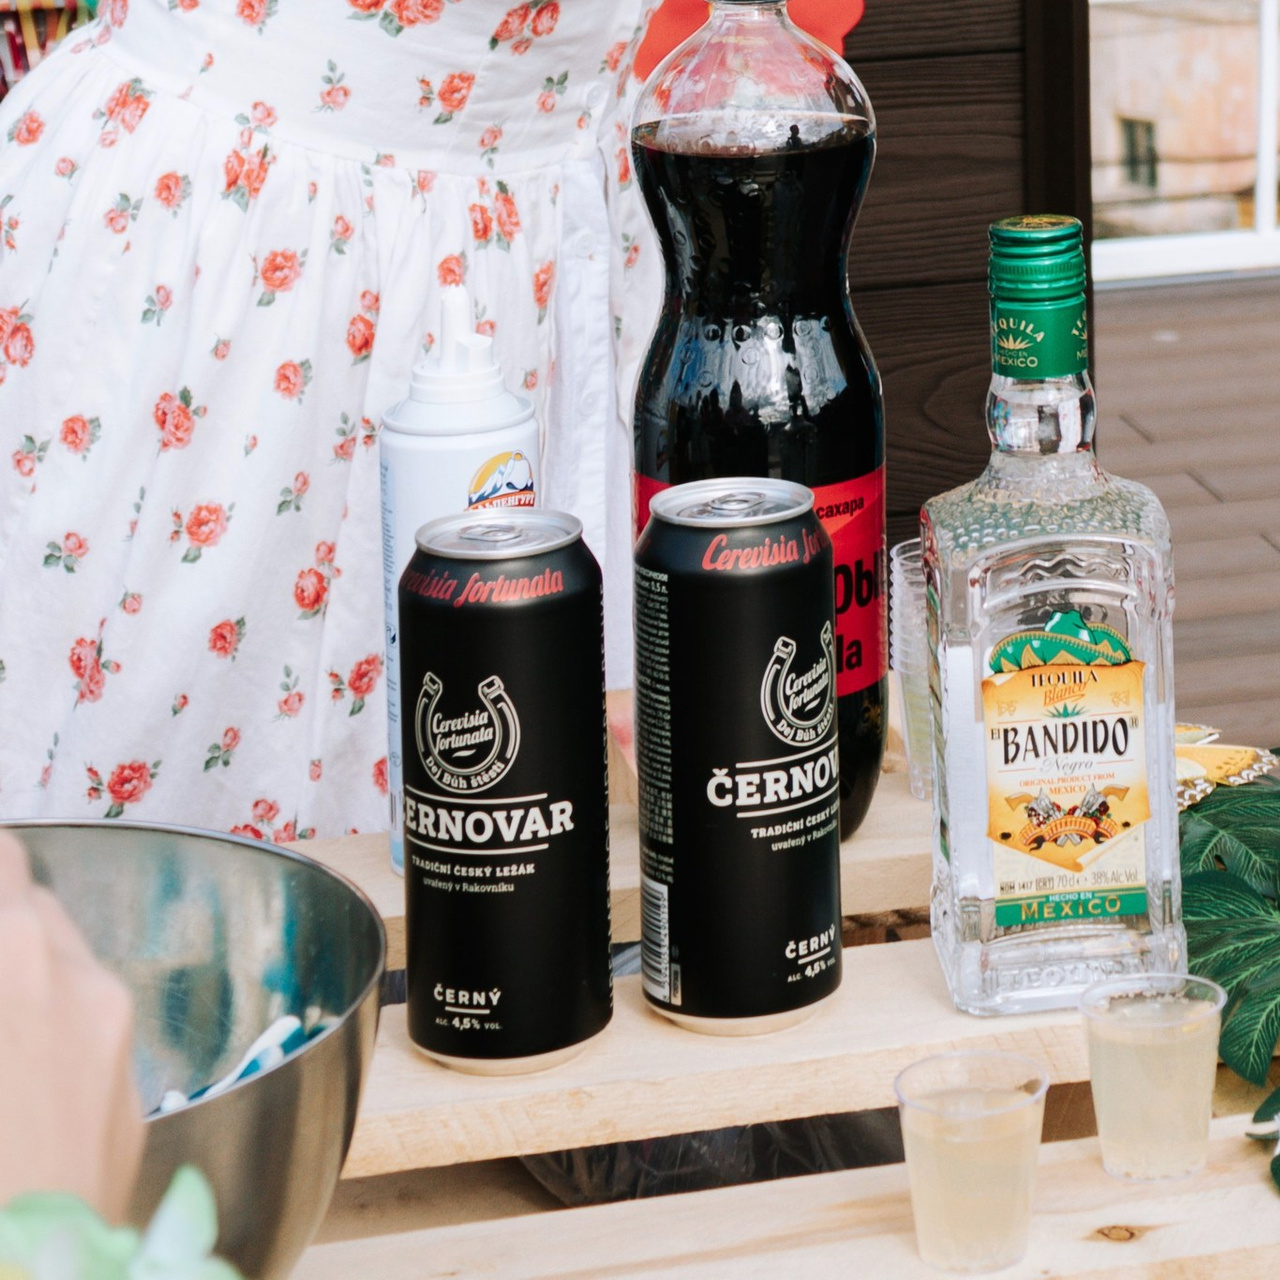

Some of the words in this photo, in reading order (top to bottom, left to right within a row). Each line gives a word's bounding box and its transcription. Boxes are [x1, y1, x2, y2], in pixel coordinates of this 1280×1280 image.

[994, 353, 1038, 368] MEXICO
[816, 497, 864, 519] сахара
[702, 534, 799, 571] Cerevisia
[453, 567, 564, 608] fortunata
[836, 634, 862, 672] la
[785, 657, 827, 696] Cerevisia
[1032, 670, 1098, 688] TEQUILA
[1044, 682, 1087, 707] Blanco
[432, 709, 489, 734] Cerevisia
[435, 726, 494, 755] fortunata
[1003, 717, 1129, 765] BANDIDO
[426, 756, 440, 779] Dej
[442, 774, 468, 789] Bůh
[470, 760, 506, 788] štěstí
[1040, 756, 1094, 775] Negro
[1020, 778, 1054, 787] ORIGINAL
[1057, 775, 1091, 783] PRODUCT
[1094, 772, 1115, 780] FROM
[1050, 785, 1087, 795] MEXICO
[404, 796, 574, 843] ERNOVAR
[751, 818, 805, 839] TRADIČNÍ
[805, 807, 830, 827] ČESKÝ
[412, 855, 451, 875] TRADIČNÍ
[454, 863, 491, 877] ČESKÝ
[496, 863, 535, 877] LEŽÁK
[455, 884, 460, 892] v
[462, 882, 515, 893] Rakovníku
[1049, 893, 1078, 902] HECHO
[1080, 892, 1093, 900] EN
[1021, 895, 1121, 921] MEXICO
[785, 923, 835, 959] ČERNÝ
[434, 983, 501, 1006] ČERNÝ
[452, 1016, 481, 1031] 4,5%
